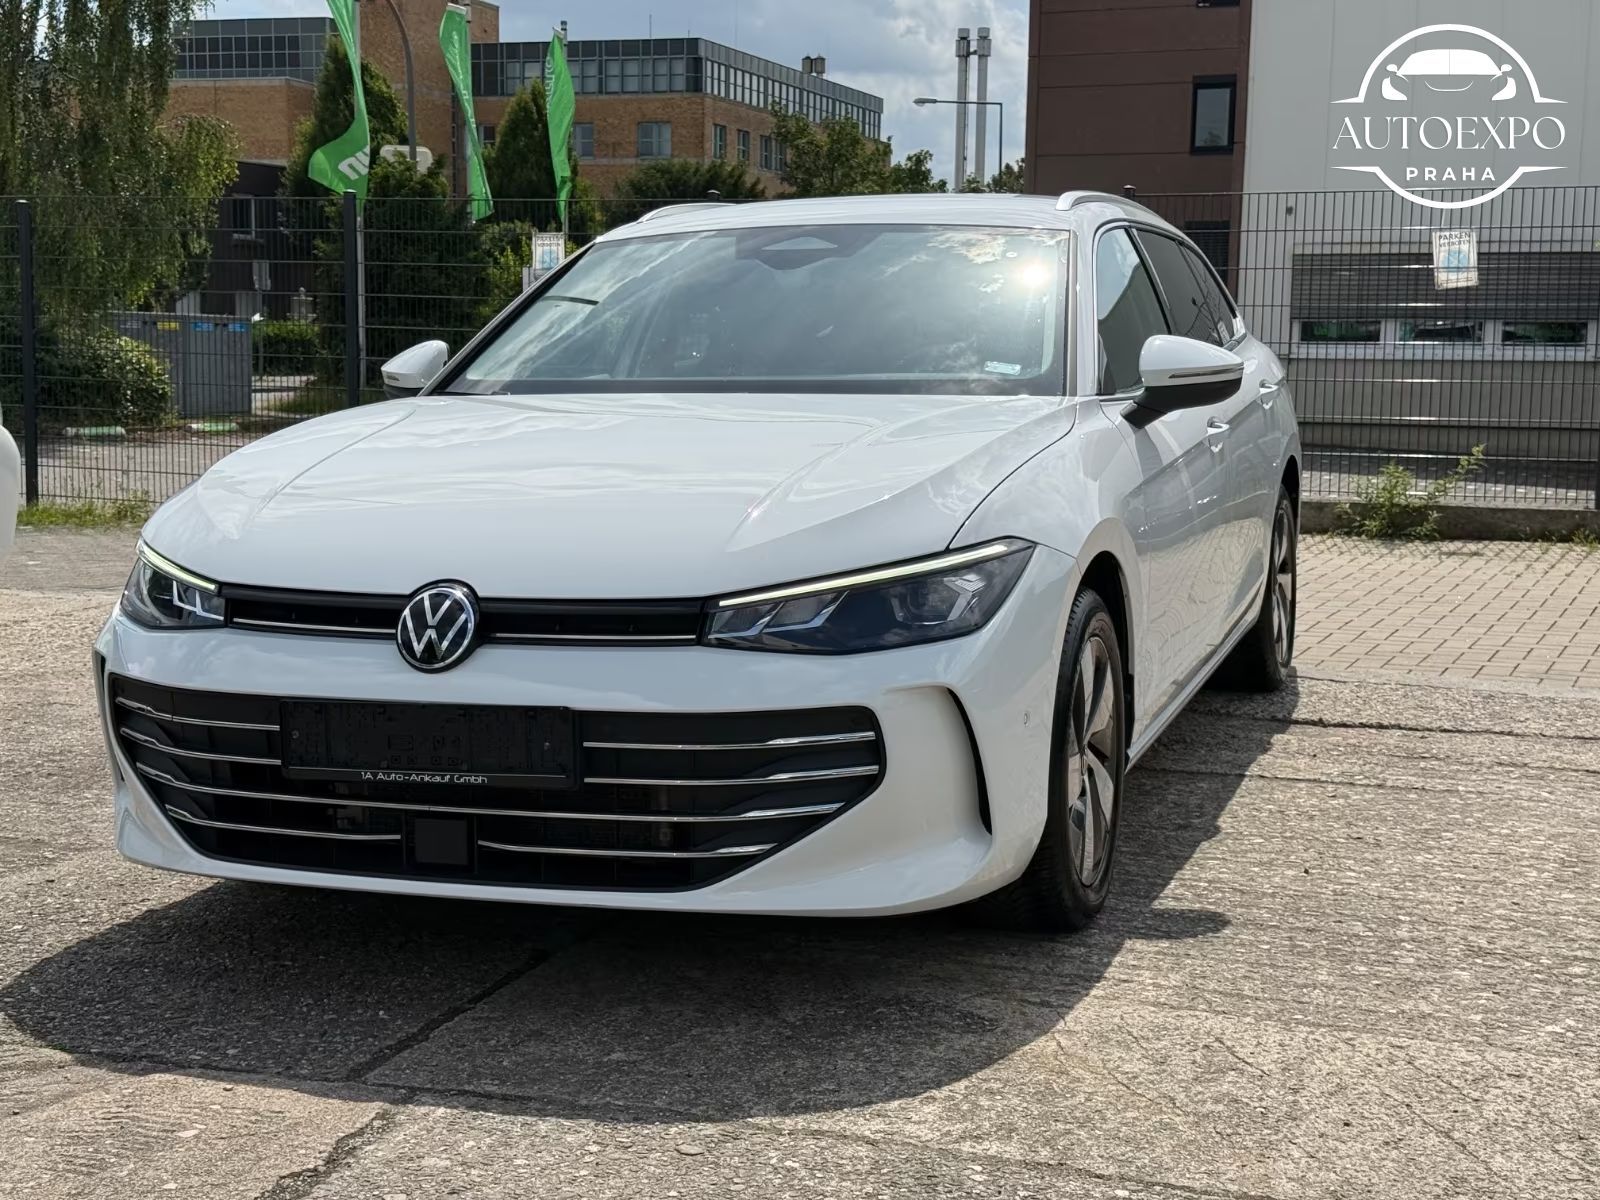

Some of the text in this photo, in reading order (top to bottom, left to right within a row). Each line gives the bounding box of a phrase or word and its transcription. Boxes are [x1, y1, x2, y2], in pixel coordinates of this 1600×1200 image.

[1438, 232, 1471, 241] PARKEN
[401, 592, 470, 662] VW
[361, 772, 373, 780] 1A
[376, 772, 451, 783] Auto-Ankauf
